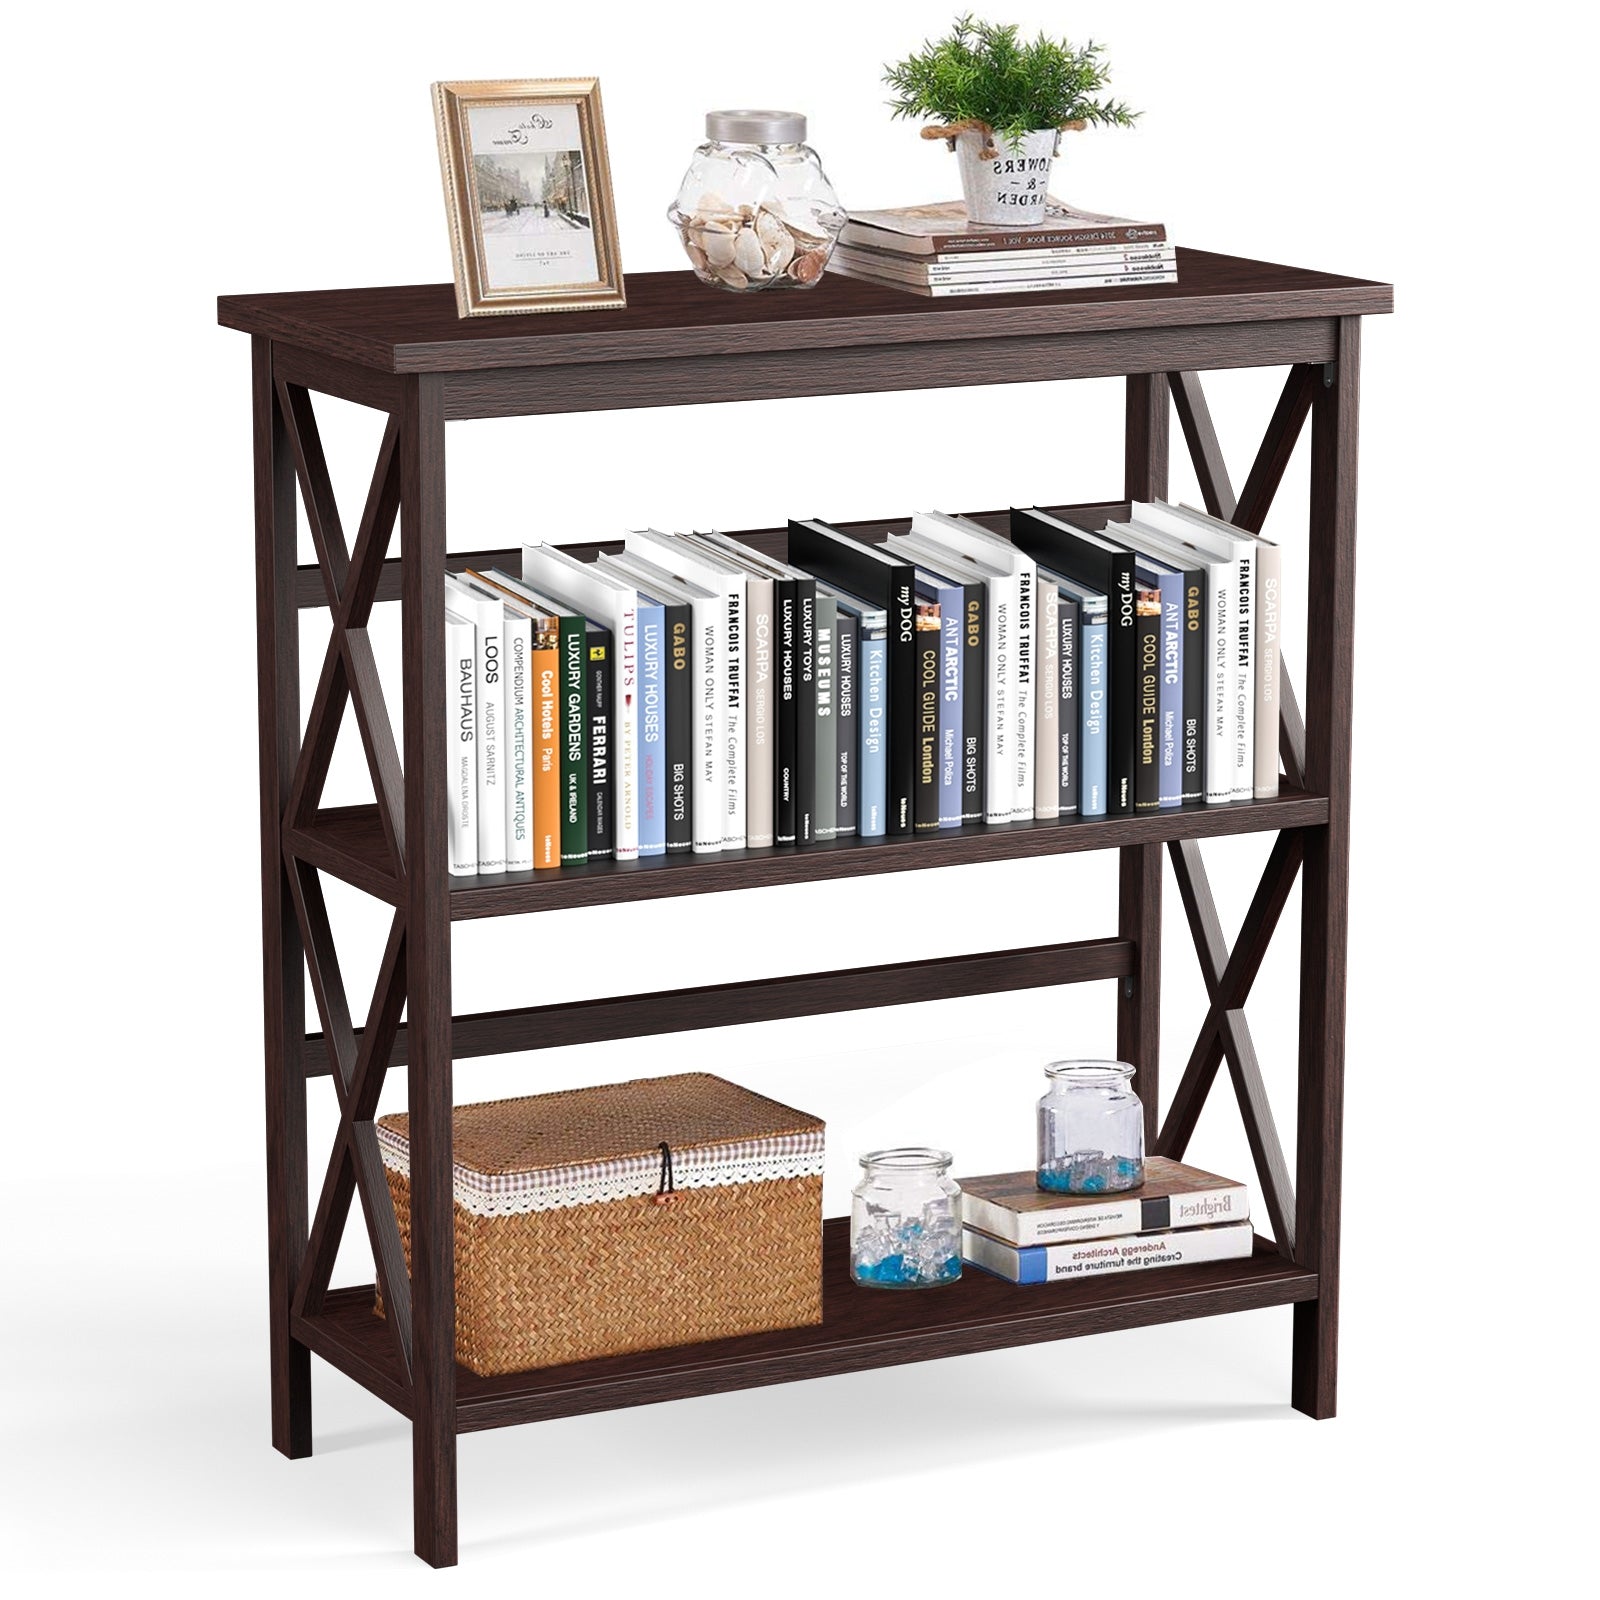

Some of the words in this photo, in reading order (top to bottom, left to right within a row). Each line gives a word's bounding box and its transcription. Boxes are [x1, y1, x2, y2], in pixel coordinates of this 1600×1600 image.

[897, 585, 909, 606] my
[1019, 572, 1031, 630] FRANCOIS
[1117, 571, 1130, 592] my
[1238, 558, 1250, 615] FRANCOIS
[728, 593, 740, 653] FRANCOIS
[783, 599, 793, 647] LUXURY
[803, 598, 813, 646] LUXURY
[900, 607, 913, 643] DOG
[967, 600, 980, 647] GABO
[997, 603, 1007, 650] WOMAN
[1045, 591, 1058, 660] SCARPA
[1120, 592, 1133, 627] DOG
[1187, 586, 1200, 632] GABO
[1217, 588, 1227, 635] WOMAN
[1264, 578, 1278, 644] SCARPA
[624, 608, 635, 687] TULIPS
[644, 624, 658, 680] LUXURY
[673, 622, 686, 671] GABO
[704, 625, 715, 674] WOMAN
[755, 613, 769, 684] SCARPA
[841, 634, 852, 673] LUXURY
[1018, 634, 1030, 684] TRUFFAT
[1062, 618, 1073, 658] LUXURY
[1143, 634, 1156, 671] COOL
[1164, 602, 1179, 685] ANTARCTIC
[1217, 638, 1227, 669] ONLY
[1238, 620, 1249, 668] TRUFFAT
[485, 636, 499, 684] LOOS
[513, 637, 524, 705] COMPENDIUM
[567, 633, 580, 690] LUXURY
[783, 650, 793, 701] HOUSES
[803, 649, 813, 682] TOYS
[817, 628, 832, 717] MUSEUMS
[869, 650, 883, 702] Kitchen
[922, 650, 936, 688] COOL
[945, 617, 959, 702] ANTARCTIC
[997, 654, 1007, 685] ONLY
[1062, 659, 1073, 700] HOUSES
[1090, 634, 1104, 685] Kitchen
[459, 658, 473, 742] BAUHAUS
[541, 669, 554, 698] Cool
[704, 678, 715, 710] ONLY
[728, 658, 740, 709] TRUFFAT
[841, 675, 852, 717] HOUSES
[1018, 690, 1028, 708] The
[1143, 674, 1156, 715] GUIDE
[1216, 673, 1225, 713] STEFAN
[1238, 673, 1247, 691] The
[486, 702, 495, 741] AUGUST
[541, 701, 554, 740] Hotels
[644, 684, 659, 743] HOUSES
[728, 715, 738, 733] The
[755, 688, 766, 724] SERGIO
[922, 692, 936, 733] GUIDE
[996, 689, 1006, 730] STEFAN
[1086, 690, 1104, 735] Design
[1164, 710, 1175, 741] Michael
[1186, 718, 1197, 736] BIG
[1216, 716, 1224, 737] MAY
[1235, 693, 1246, 740] Complete
[514, 708, 525, 789] ARCHITECTURAL
[568, 693, 581, 762] GARDENS
[624, 721, 632, 736] BY
[704, 714, 713, 757] STEFAN
[755, 725, 765, 745] LOS
[866, 708, 883, 753] Design
[944, 728, 955, 760] Michael
[966, 736, 977, 755] BIG
[996, 734, 1005, 756] MAY
[1016, 711, 1027, 759] Complete
[1142, 718, 1155, 765] London
[486, 744, 495, 786] SARNITZ
[542, 747, 554, 772] Paris
[593, 716, 607, 785] FERRARI
[624, 740, 632, 777] PETER
[726, 737, 738, 785] Complete
[922, 737, 935, 784] London
[1186, 737, 1197, 773] SHOTS
[1237, 742, 1246, 768] Films
[673, 763, 684, 782] BIG
[704, 761, 713, 783] MAY
[944, 761, 955, 787] Poliza
[966, 756, 977, 793] SHOTS
[1017, 761, 1027, 788] Films
[513, 790, 525, 841] ANTIQUES
[624, 781, 632, 830] ARNOLD
[673, 784, 685, 821] SHOTS
[728, 788, 738, 816] Films
